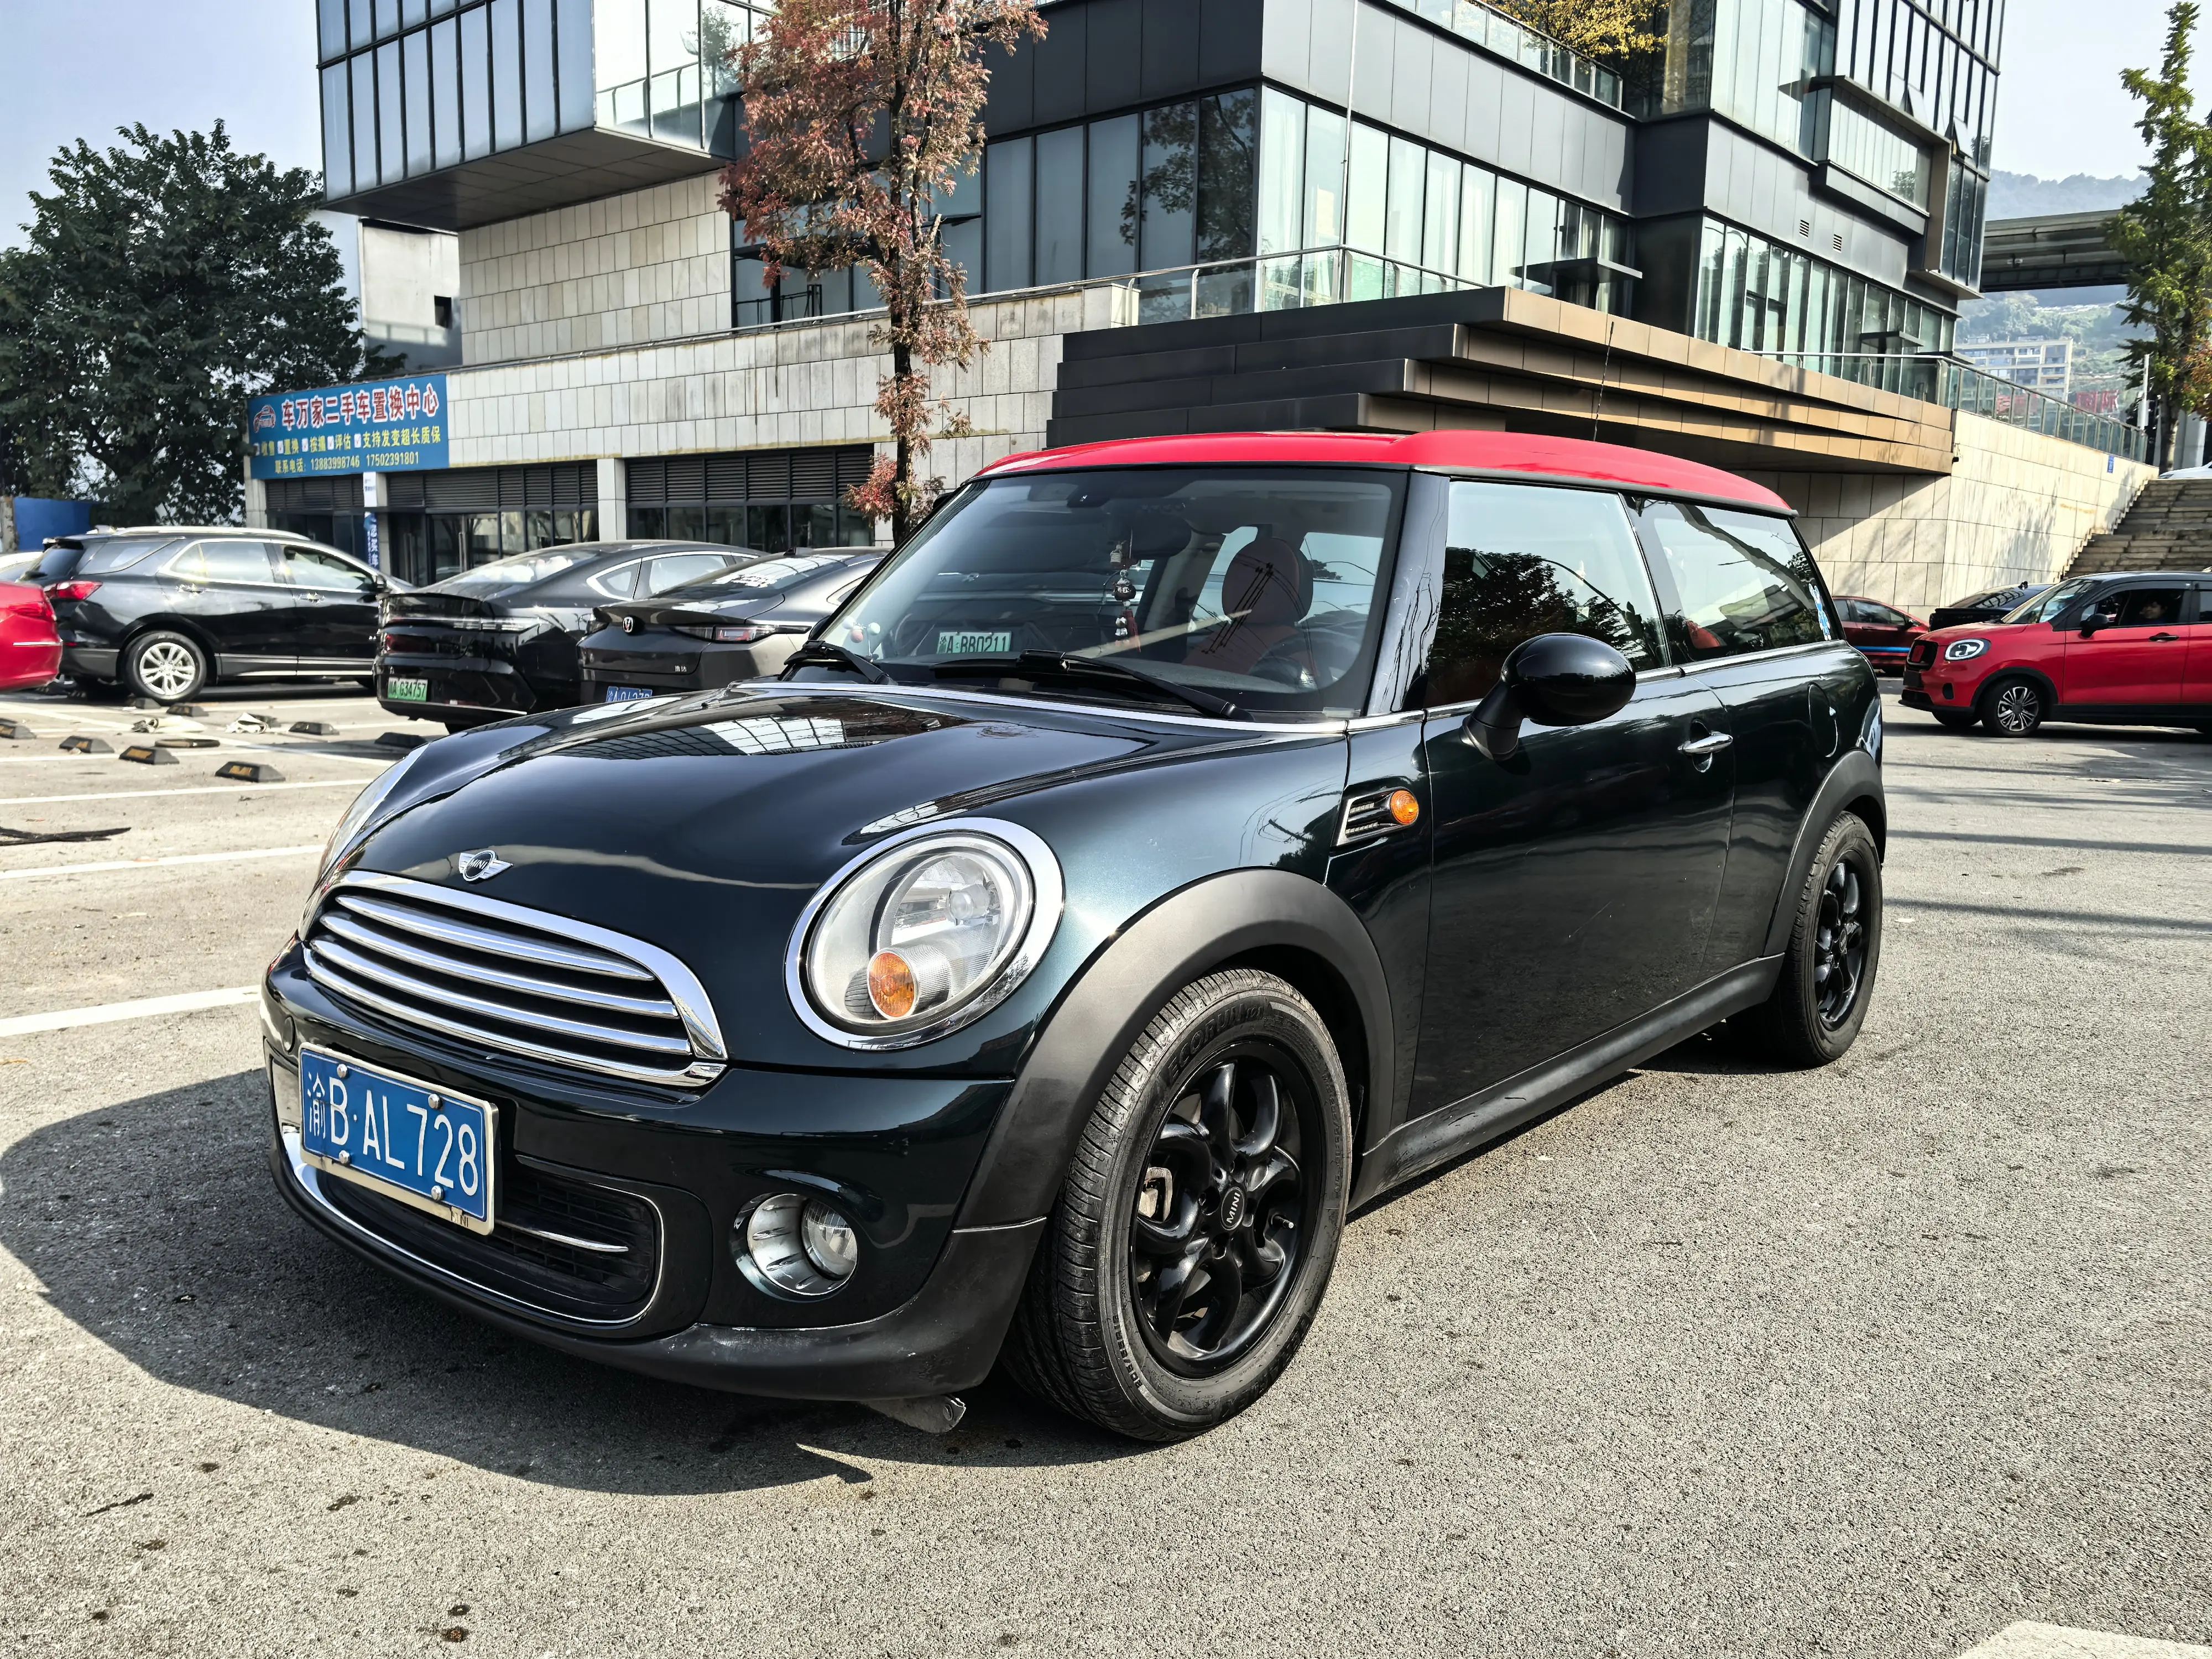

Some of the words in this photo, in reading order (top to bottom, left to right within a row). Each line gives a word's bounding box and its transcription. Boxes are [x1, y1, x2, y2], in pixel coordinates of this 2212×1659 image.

[281, 383, 439, 431] 车万家二手车置换中心
[366, 451, 419, 467] 17502391801
[468, 858, 488, 870] MINI
[1226, 1192, 1241, 1224] MINI
